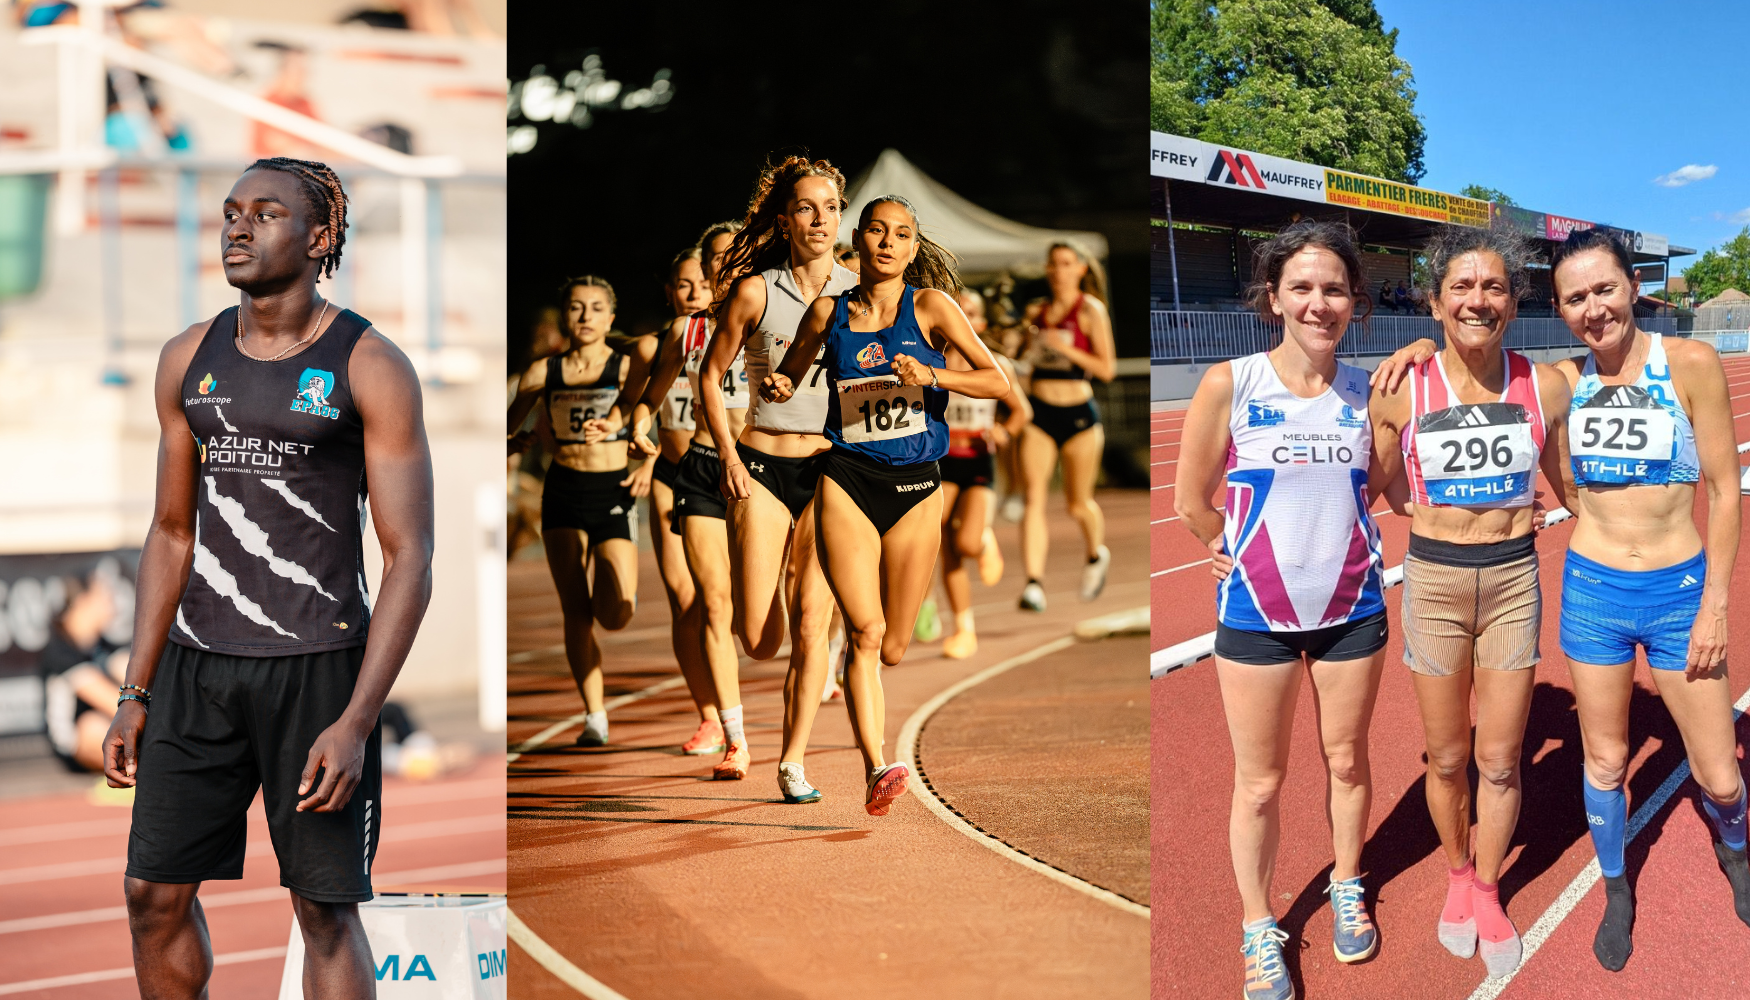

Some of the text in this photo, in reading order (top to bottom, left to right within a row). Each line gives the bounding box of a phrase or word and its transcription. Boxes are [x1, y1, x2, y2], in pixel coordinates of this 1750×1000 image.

[1152, 149, 1198, 168] FFREY
[1260, 169, 1323, 191] MAUFFREY
[1327, 172, 1448, 210] PARMENTIER FRERÈS
[1329, 192, 1361, 207] ELAGAGE
[1366, 199, 1400, 213] ABATTAGE
[1449, 195, 1466, 207] VENTE
[852, 380, 907, 394] INTERSPO
[185, 397, 232, 407] futuroscope
[859, 396, 910, 433] 182
[1283, 433, 1342, 441] MEUBLES
[1581, 417, 1649, 451] 525
[208, 436, 315, 456] AZUR NET
[1272, 446, 1353, 464] CELIO
[1440, 434, 1513, 473] 296
[209, 451, 282, 467] POITOU
[896, 480, 935, 493] KIPRUN
